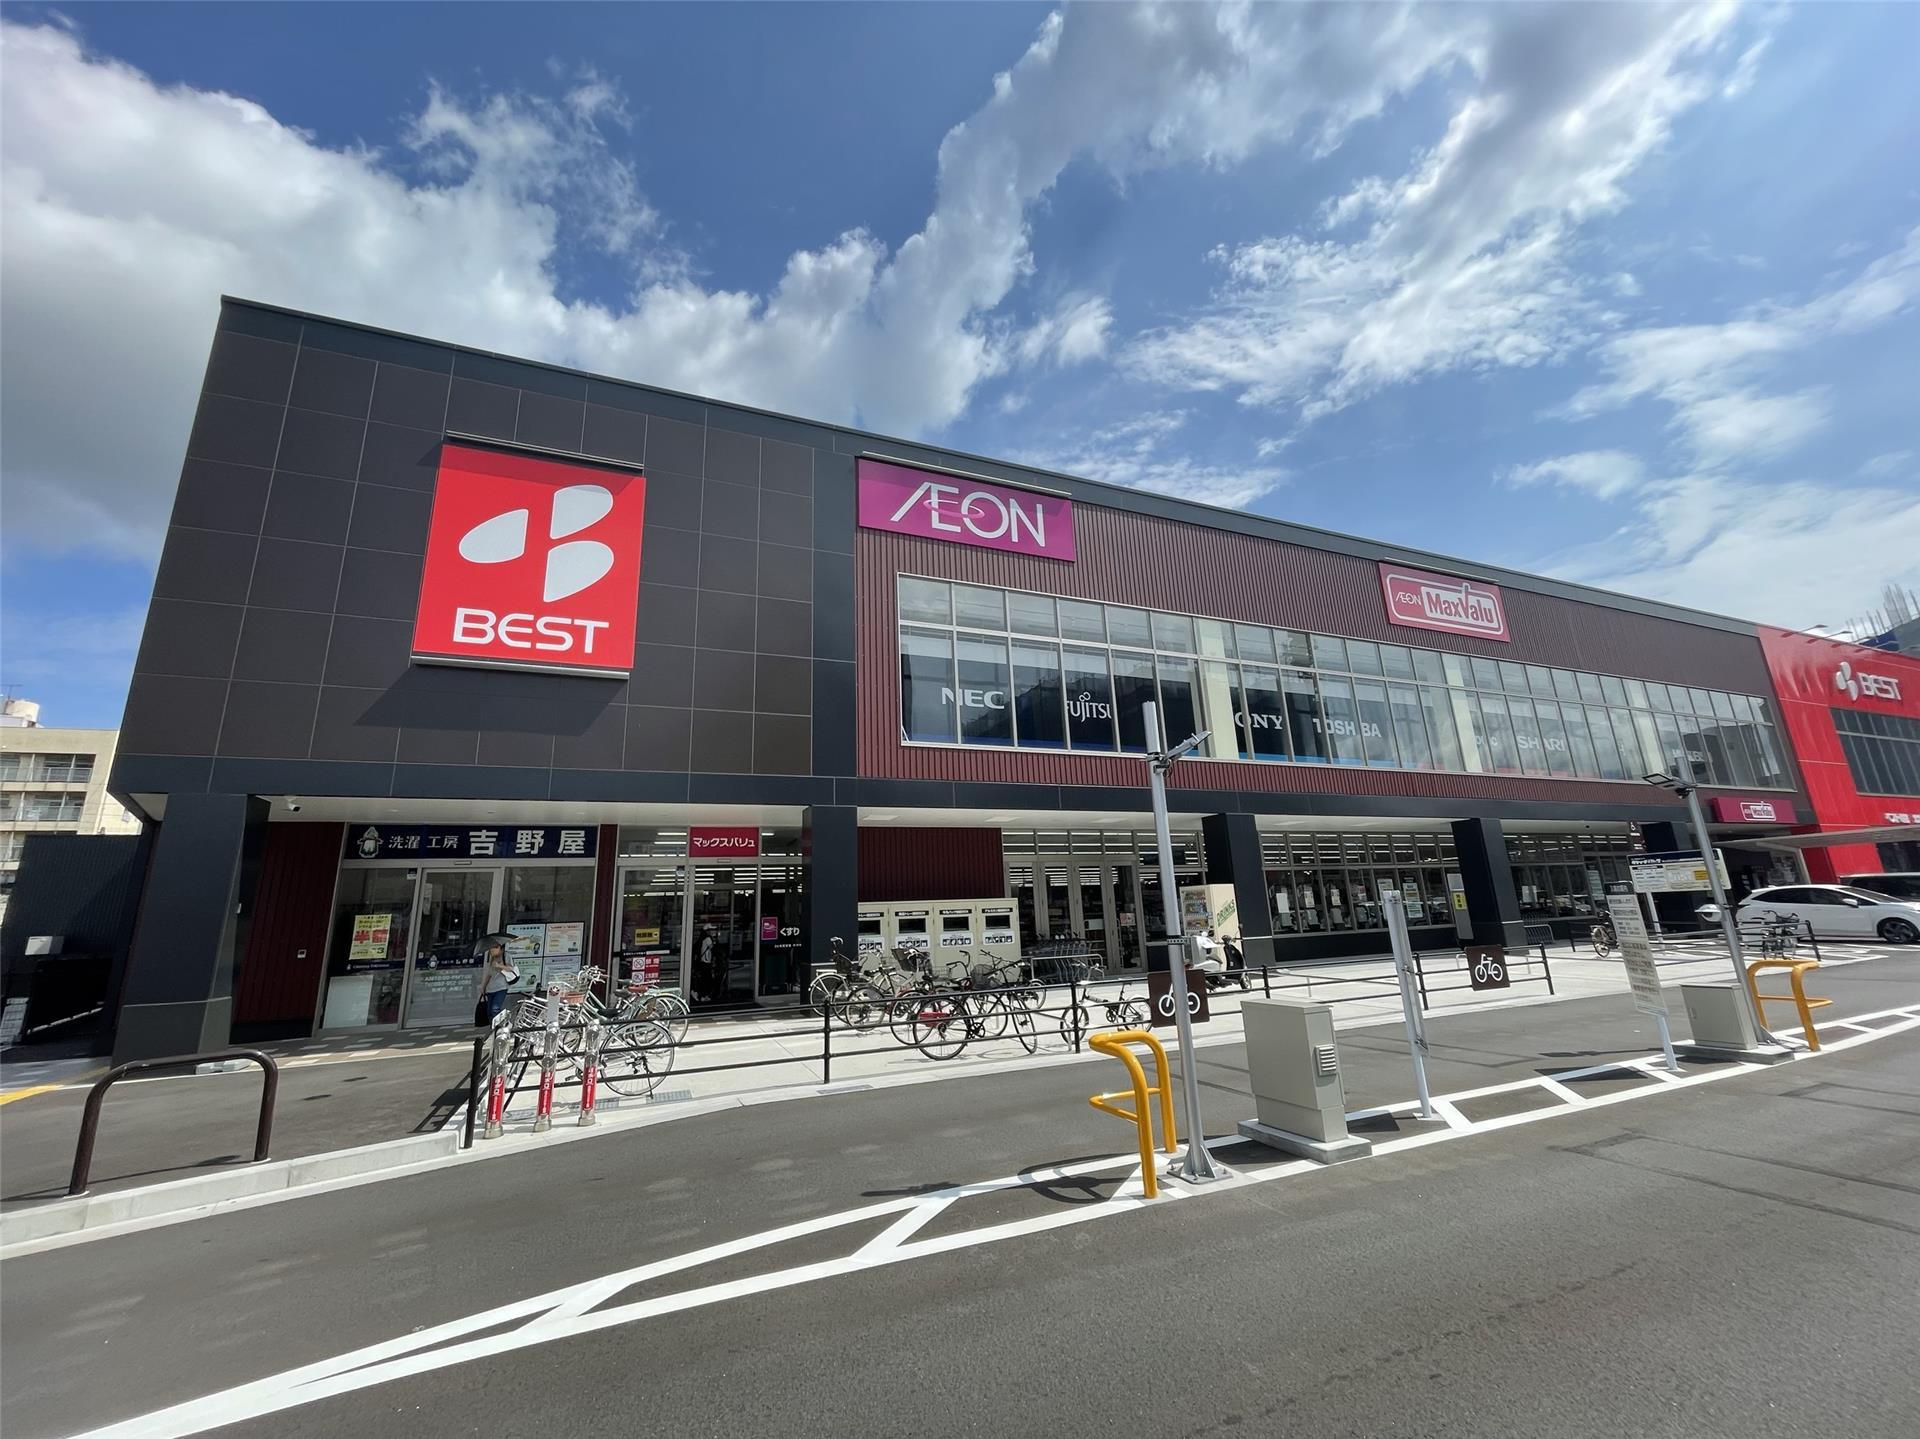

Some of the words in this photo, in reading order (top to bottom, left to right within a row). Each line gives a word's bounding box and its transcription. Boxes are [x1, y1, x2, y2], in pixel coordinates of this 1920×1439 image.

[1426, 585, 1494, 624] MaxValu
[452, 607, 610, 654] BEST
[941, 687, 1005, 710] NEC
[1857, 672, 1902, 701] BEST
[388, 835, 420, 849] 洗濯
[426, 835, 459, 849] 工房
[469, 829, 586, 856] 吉野屋
[692, 837, 756, 848] マックスバリュ
